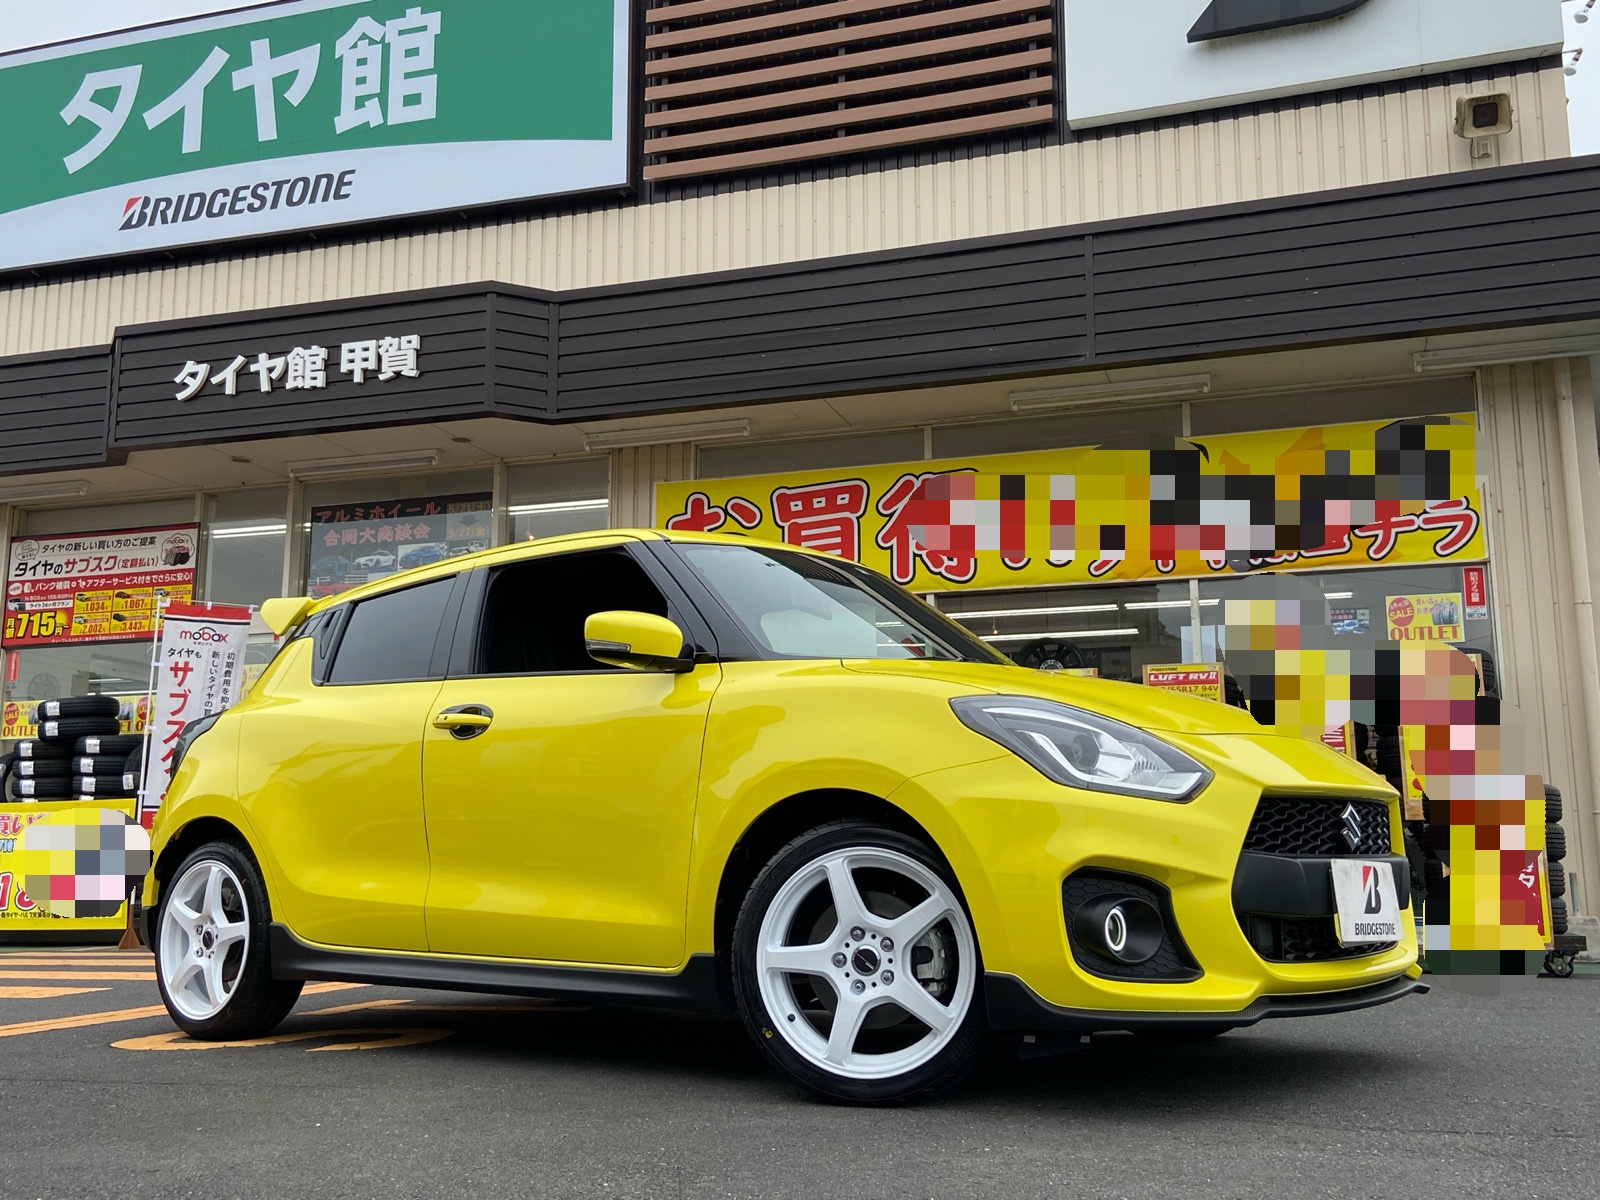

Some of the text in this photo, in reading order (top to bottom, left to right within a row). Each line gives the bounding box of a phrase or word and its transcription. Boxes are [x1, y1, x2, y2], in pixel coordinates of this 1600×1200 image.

[59, 7, 442, 175] タイヤ館
[119, 169, 356, 231] BRIDGESTONE
[173, 334, 421, 401] タイヤ館 甲賀
[317, 501, 441, 526] アルミホイール
[323, 521, 432, 546] 合同大商談会
[42, 536, 157, 553] タイヤの新しい買い方のご提案
[14, 555, 159, 577] タイヤのサブスク(定額払い)
[1390, 607, 1413, 620] SALE
[180, 627, 229, 643] mobox
[1390, 625, 1460, 641] OUTLET
[168, 647, 202, 658] タイヤも
[1150, 673, 1187, 682] LUFT
[2, 725, 38, 738] OUTLE
[1354, 922, 1396, 936] BRIDGESTONE
